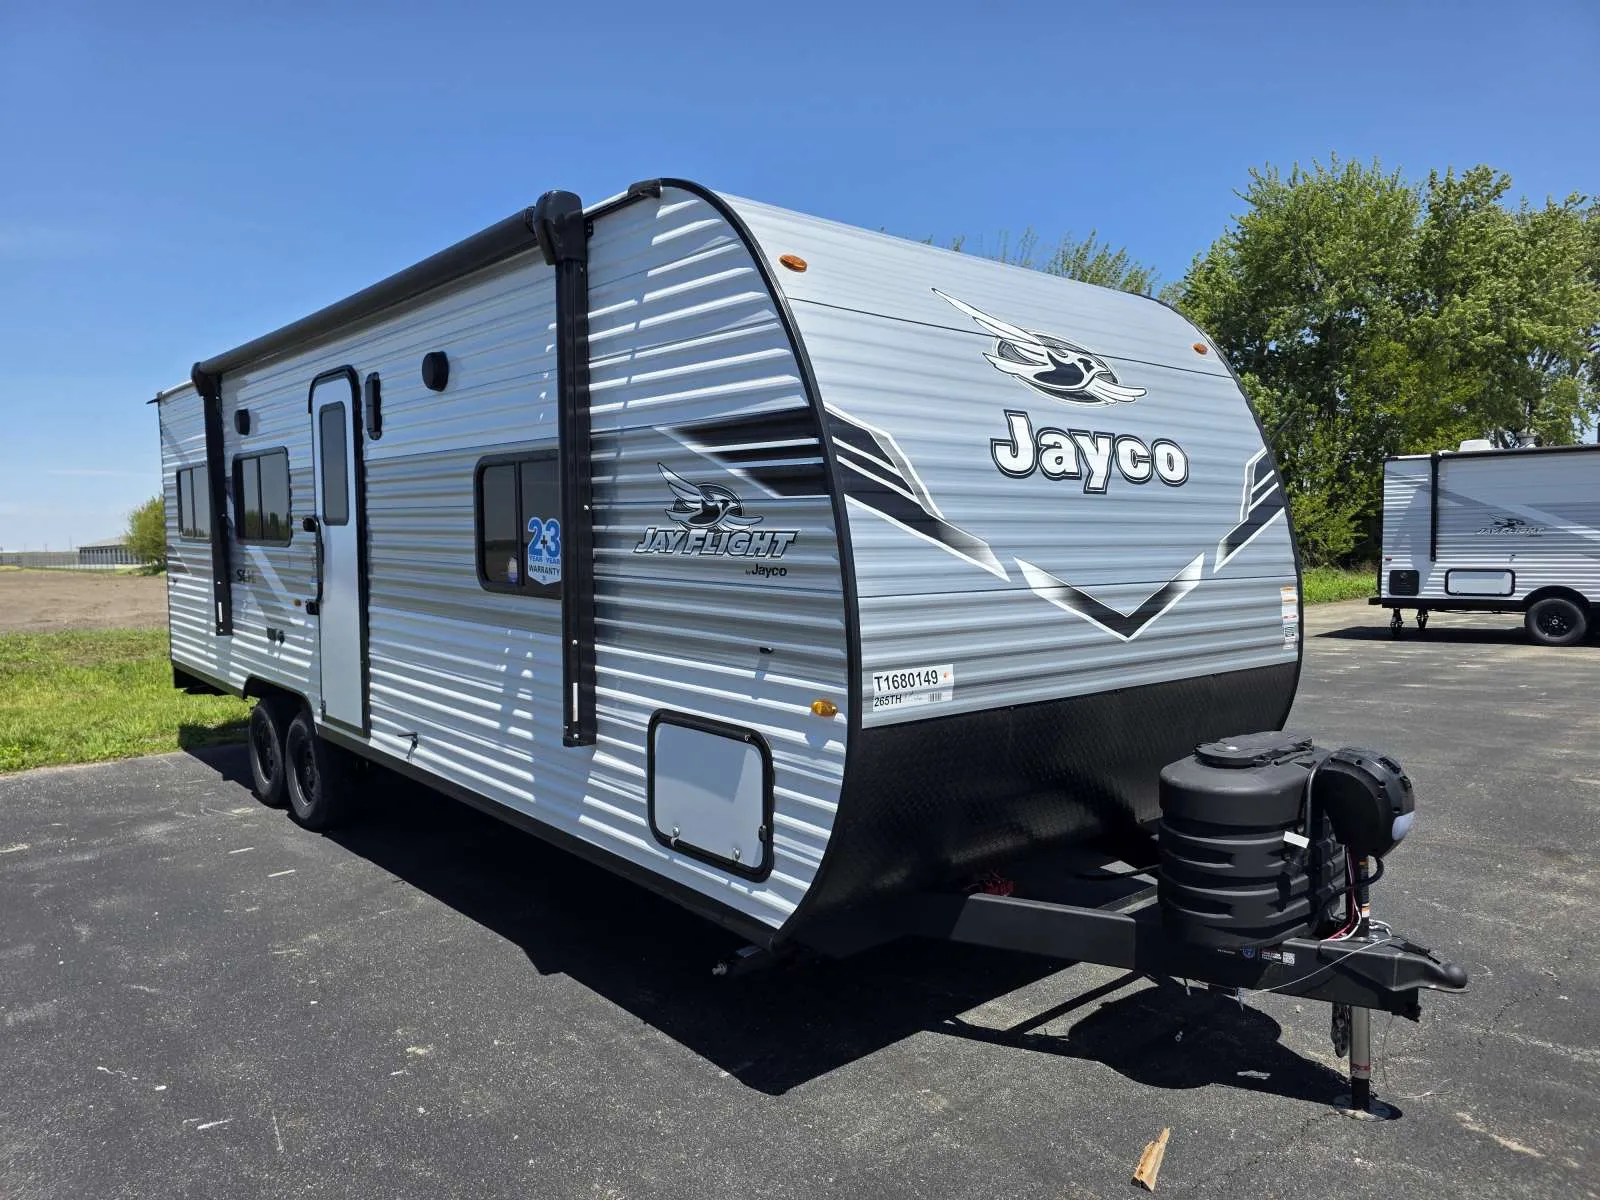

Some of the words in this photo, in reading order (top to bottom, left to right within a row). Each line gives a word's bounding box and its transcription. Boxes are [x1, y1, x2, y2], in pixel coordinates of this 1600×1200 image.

[990, 409, 1189, 494] Jayco
[682, 528, 800, 559] FLIGHT
[529, 564, 560, 576] WARRANTY
[751, 563, 788, 578] Jayco
[874, 669, 938, 692] T1680149
[874, 694, 902, 707] 265TH
